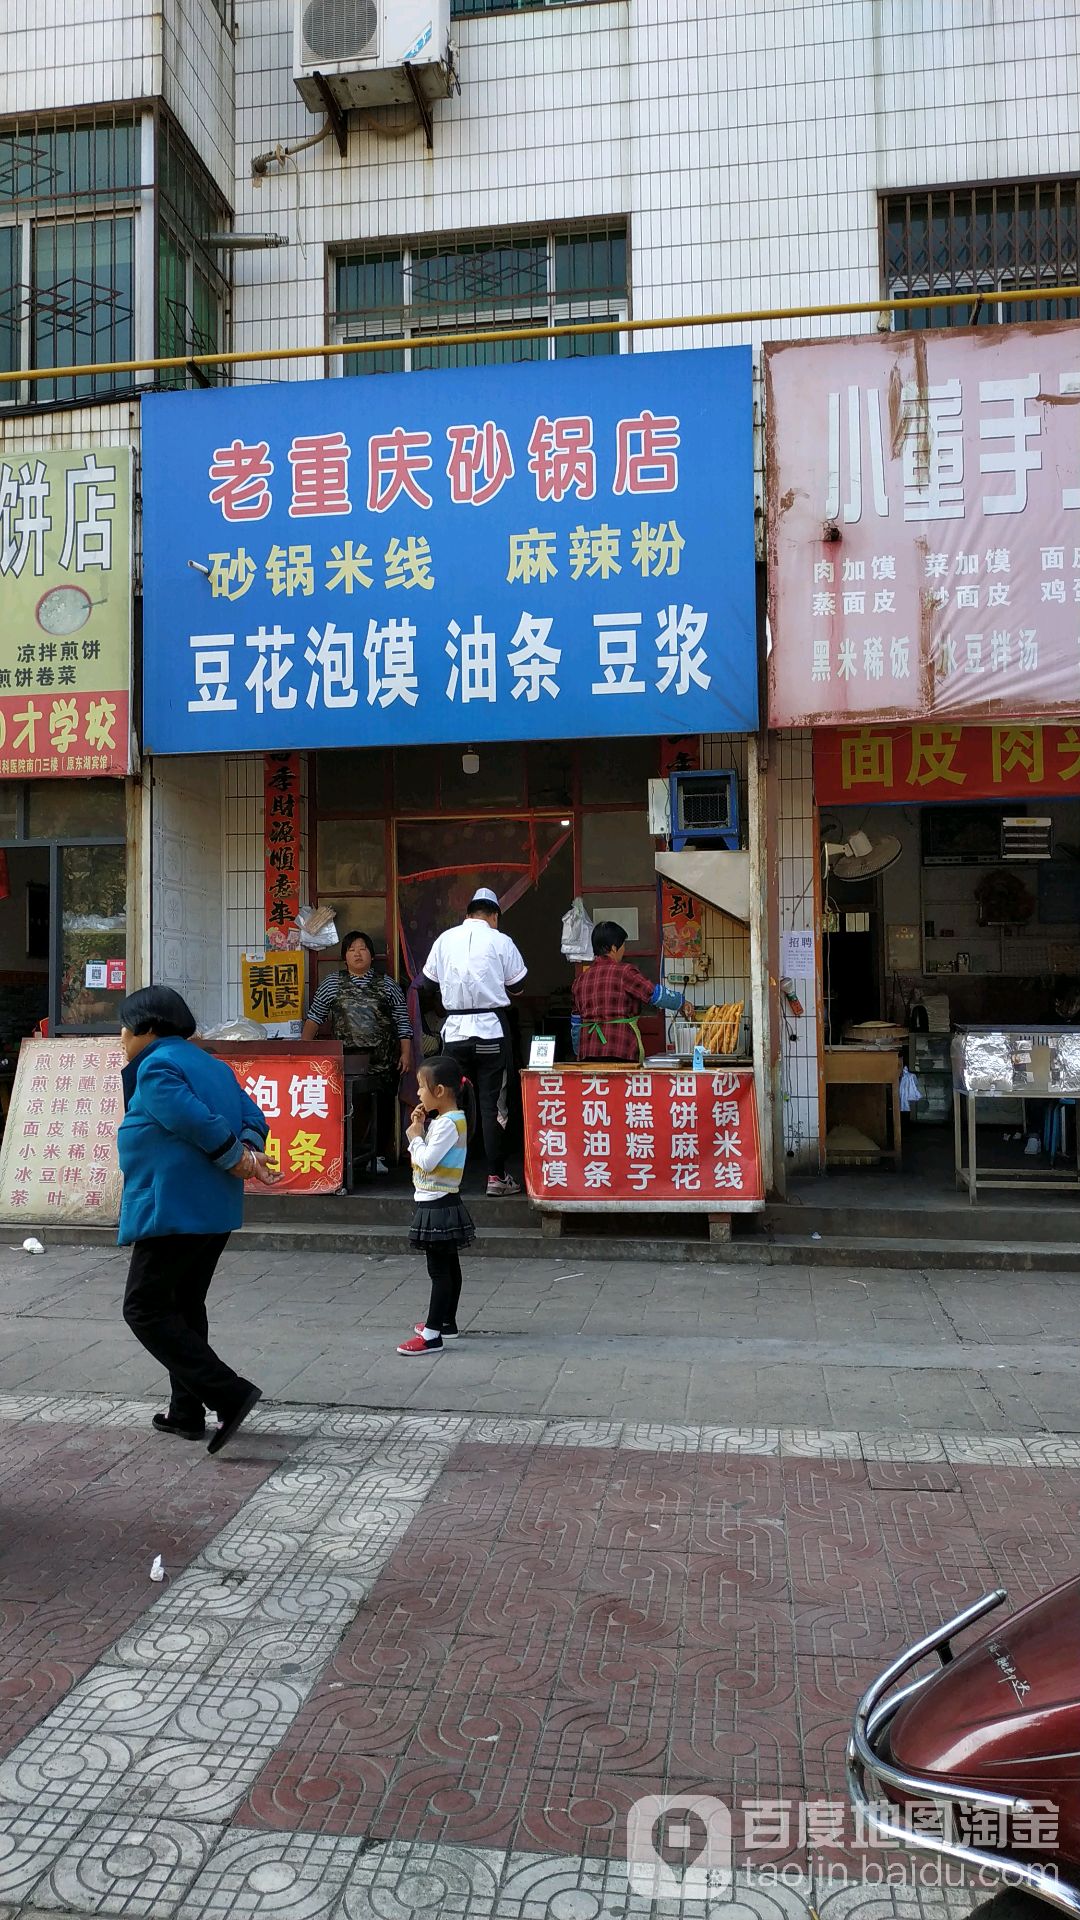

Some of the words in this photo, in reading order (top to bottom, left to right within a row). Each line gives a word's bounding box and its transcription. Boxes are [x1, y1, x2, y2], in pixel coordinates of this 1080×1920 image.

[208, 410, 682, 523] 老重庆砂锅店
[0, 453, 117, 579] 饼店
[207, 536, 436, 602] 砂锅米线
[506, 520, 686, 585] 麻辣粉
[813, 555, 897, 584] 肉加馍
[925, 548, 1011, 578] 菜加馍
[812, 588, 897, 616] 蒸面皮
[17, 640, 101, 663] 凉拌煎饼
[188, 617, 419, 714] 豆花泡馍
[445, 611, 562, 704] 油条
[592, 603, 711, 696] 豆浆
[811, 635, 911, 682] 黑米稀饭
[0, 696, 117, 754] 才学校
[837, 725, 968, 790] 面皮
[788, 937, 813, 948] 招聘
[249, 963, 299, 988] 美团
[250, 986, 300, 1018] 外卖
[34, 1053, 124, 1070] 煎饼夹菜
[26, 1097, 118, 1114] 凉拌煎饼
[23, 1120, 115, 1138] 面皮稀饭
[537, 1072, 568, 1188] 豆花泡馍
[711, 1072, 744, 1190] 砂锅米线
[19, 1143, 112, 1161] 小米稀饭
[14, 1166, 108, 1184] 冰豆拌汤
[11, 1189, 103, 1207] 茶叶蛋
